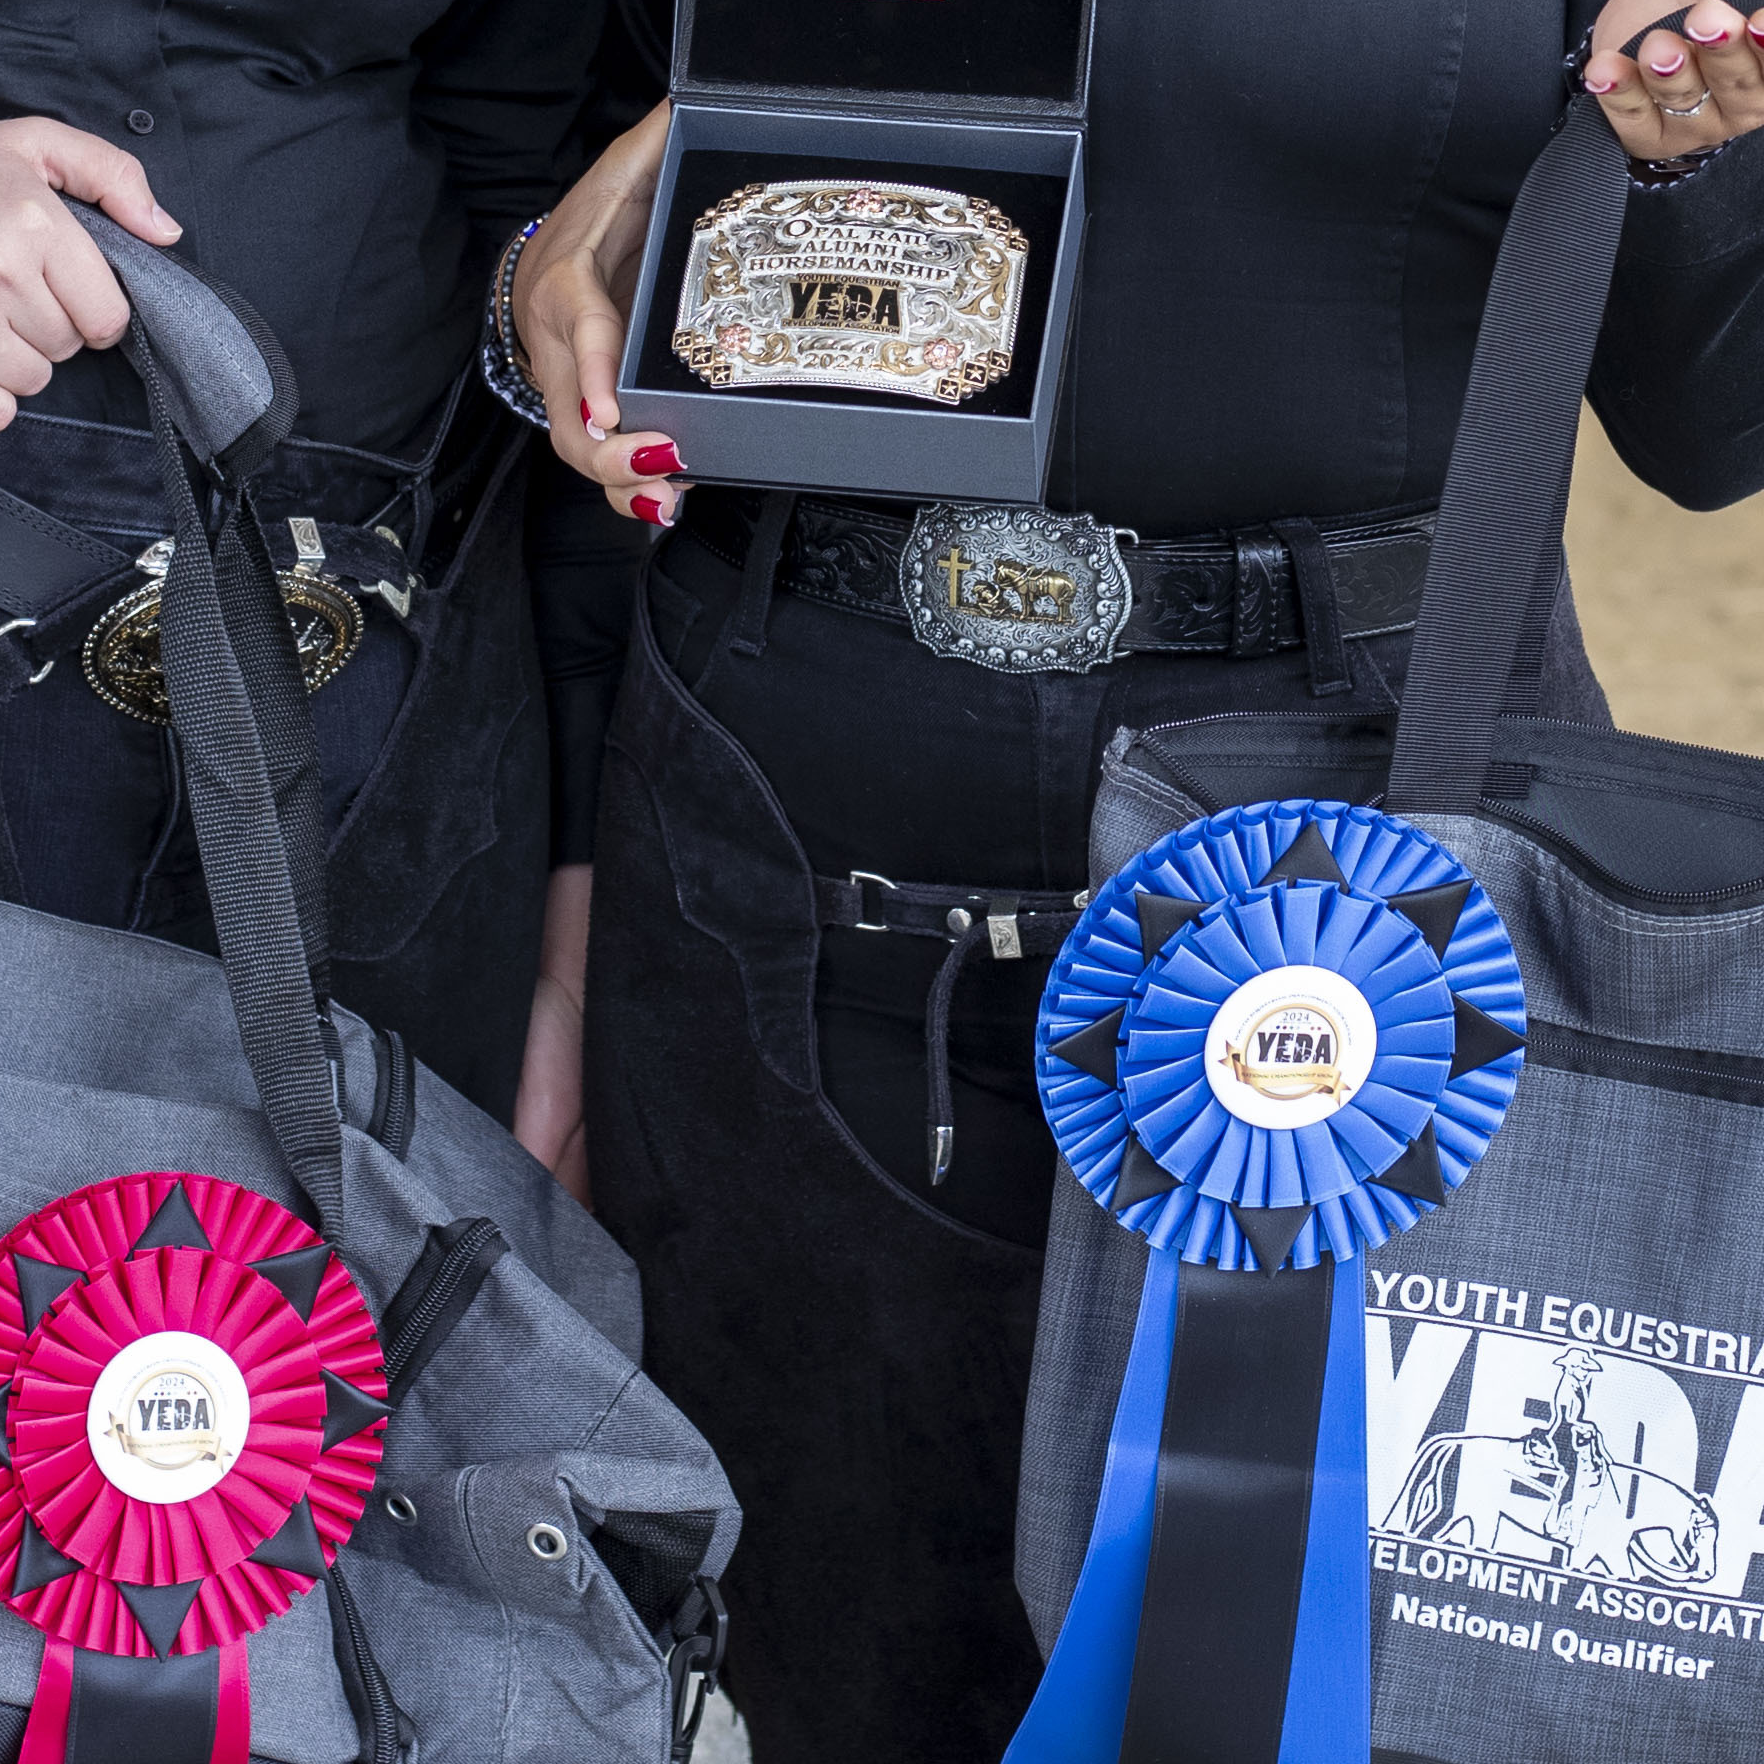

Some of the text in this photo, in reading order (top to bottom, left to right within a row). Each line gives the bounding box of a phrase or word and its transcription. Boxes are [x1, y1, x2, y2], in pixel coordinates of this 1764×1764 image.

[801, 240, 898, 257] ALUMNI
[749, 255, 951, 282] HORSEMANSHIP
[797, 273, 833, 283] YOUTH
[789, 282, 901, 328] YEDA
[781, 318, 900, 335] DEVELOPMENT ASSOCIATION
[803, 353, 865, 372] 2024
[1282, 1011, 1310, 1022] 2024
[1257, 1032, 1331, 1064] YEDA
[1370, 1270, 1529, 1328] YOUTH
[159, 1376, 185, 1387] 2024
[137, 1399, 211, 1432] YEDA
[1368, 1538, 1568, 1606] ELOPMENT
[1391, 1592, 1715, 1680] National Qualifier
